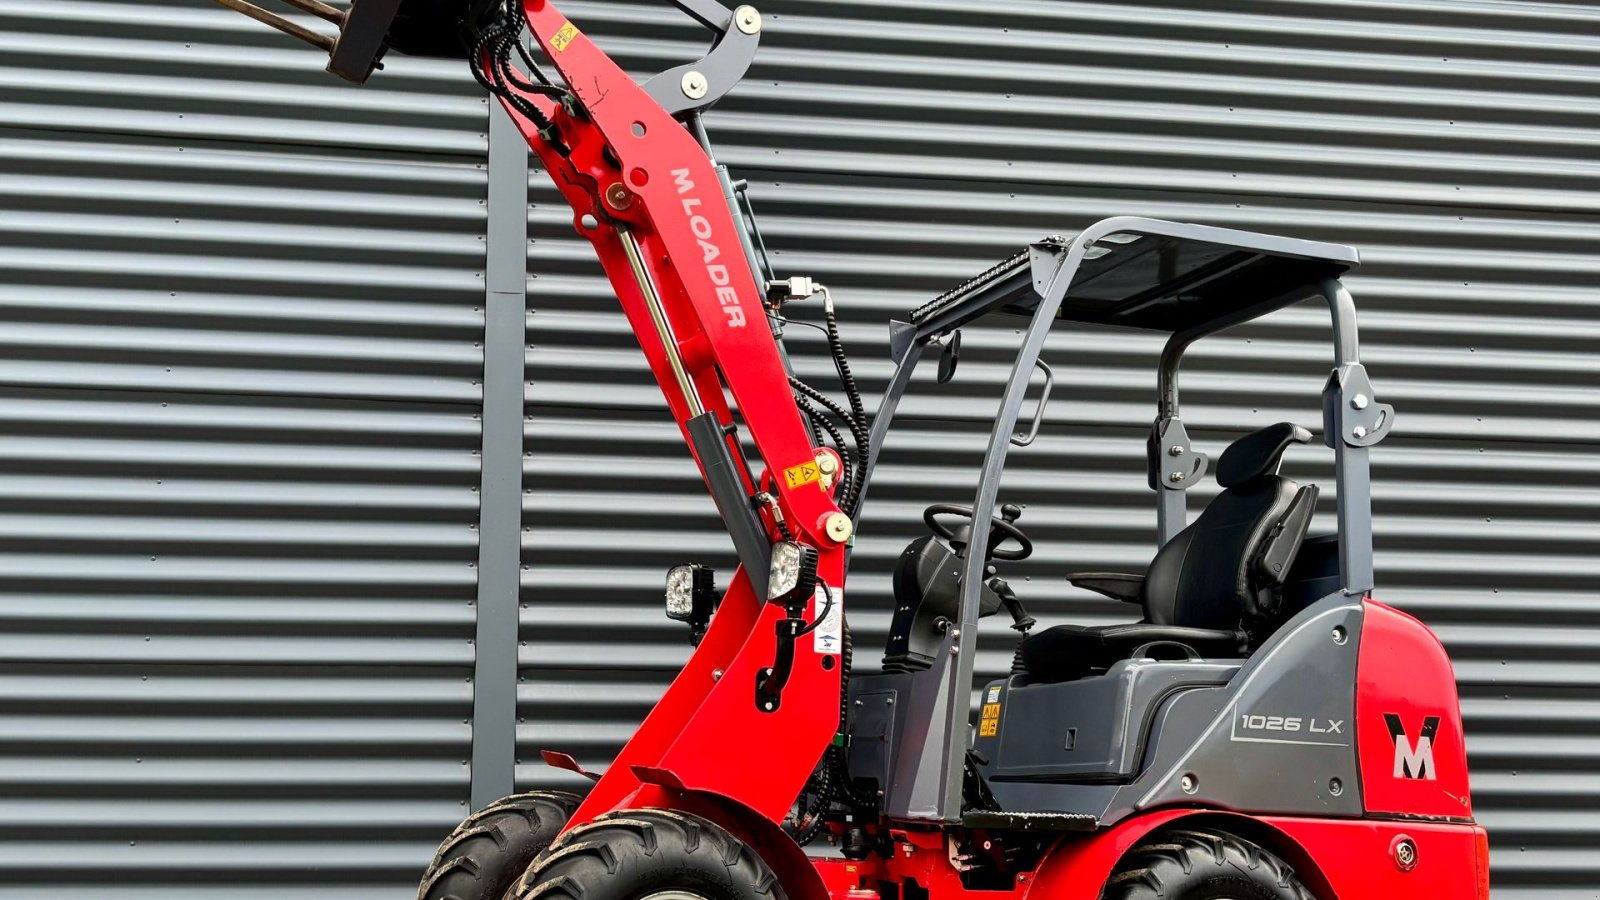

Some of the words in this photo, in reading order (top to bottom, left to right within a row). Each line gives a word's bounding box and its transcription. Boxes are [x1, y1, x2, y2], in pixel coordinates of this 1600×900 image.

[670, 167, 696, 195] M
[681, 198, 747, 328] LOADER
[1242, 714, 1303, 732] 1026
[1309, 718, 1344, 734] LX
